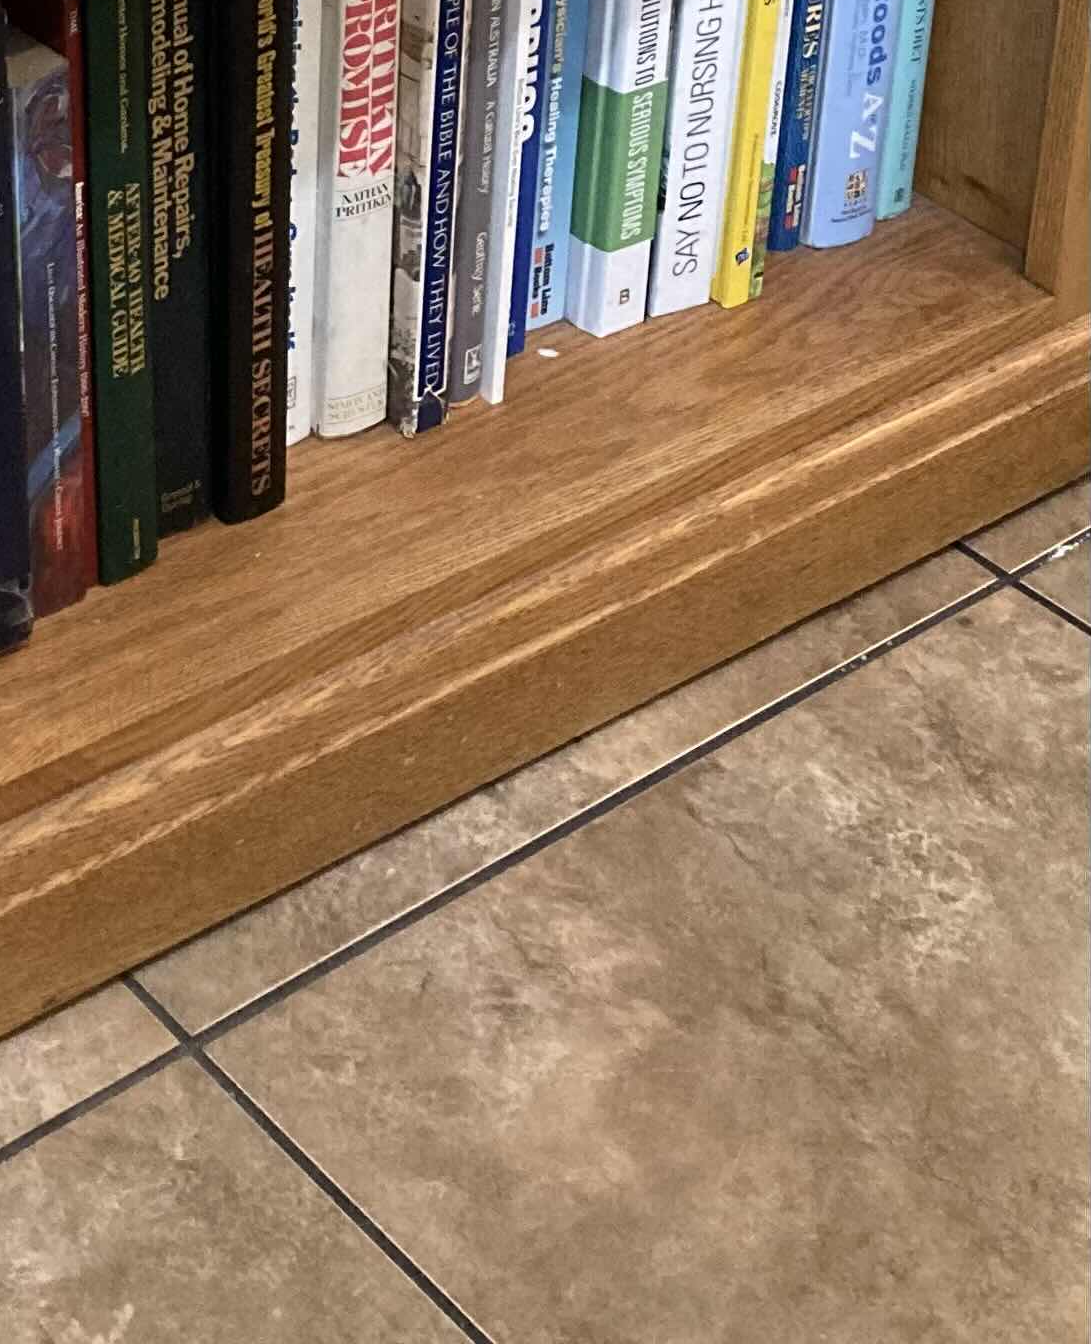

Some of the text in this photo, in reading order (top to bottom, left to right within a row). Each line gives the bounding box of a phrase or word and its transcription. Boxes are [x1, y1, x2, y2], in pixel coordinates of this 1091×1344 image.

[443, 32, 458, 60] OF
[440, 63, 458, 94] THE
[635, 65, 655, 86] TO
[688, 19, 721, 136] NURSING
[438, 98, 454, 162] BIBLE
[629, 91, 653, 157] SERIOUS
[683, 142, 709, 177] TO
[436, 168, 454, 215] AND
[620, 155, 648, 239] SYMPTOMS
[677, 182, 705, 222] NO
[431, 217, 448, 268] HOW
[673, 231, 700, 277] SAY
[107, 190, 129, 378] & MEDICAL GUIDE
[428, 273, 446, 324] THEY
[424, 332, 443, 389] LIVED
